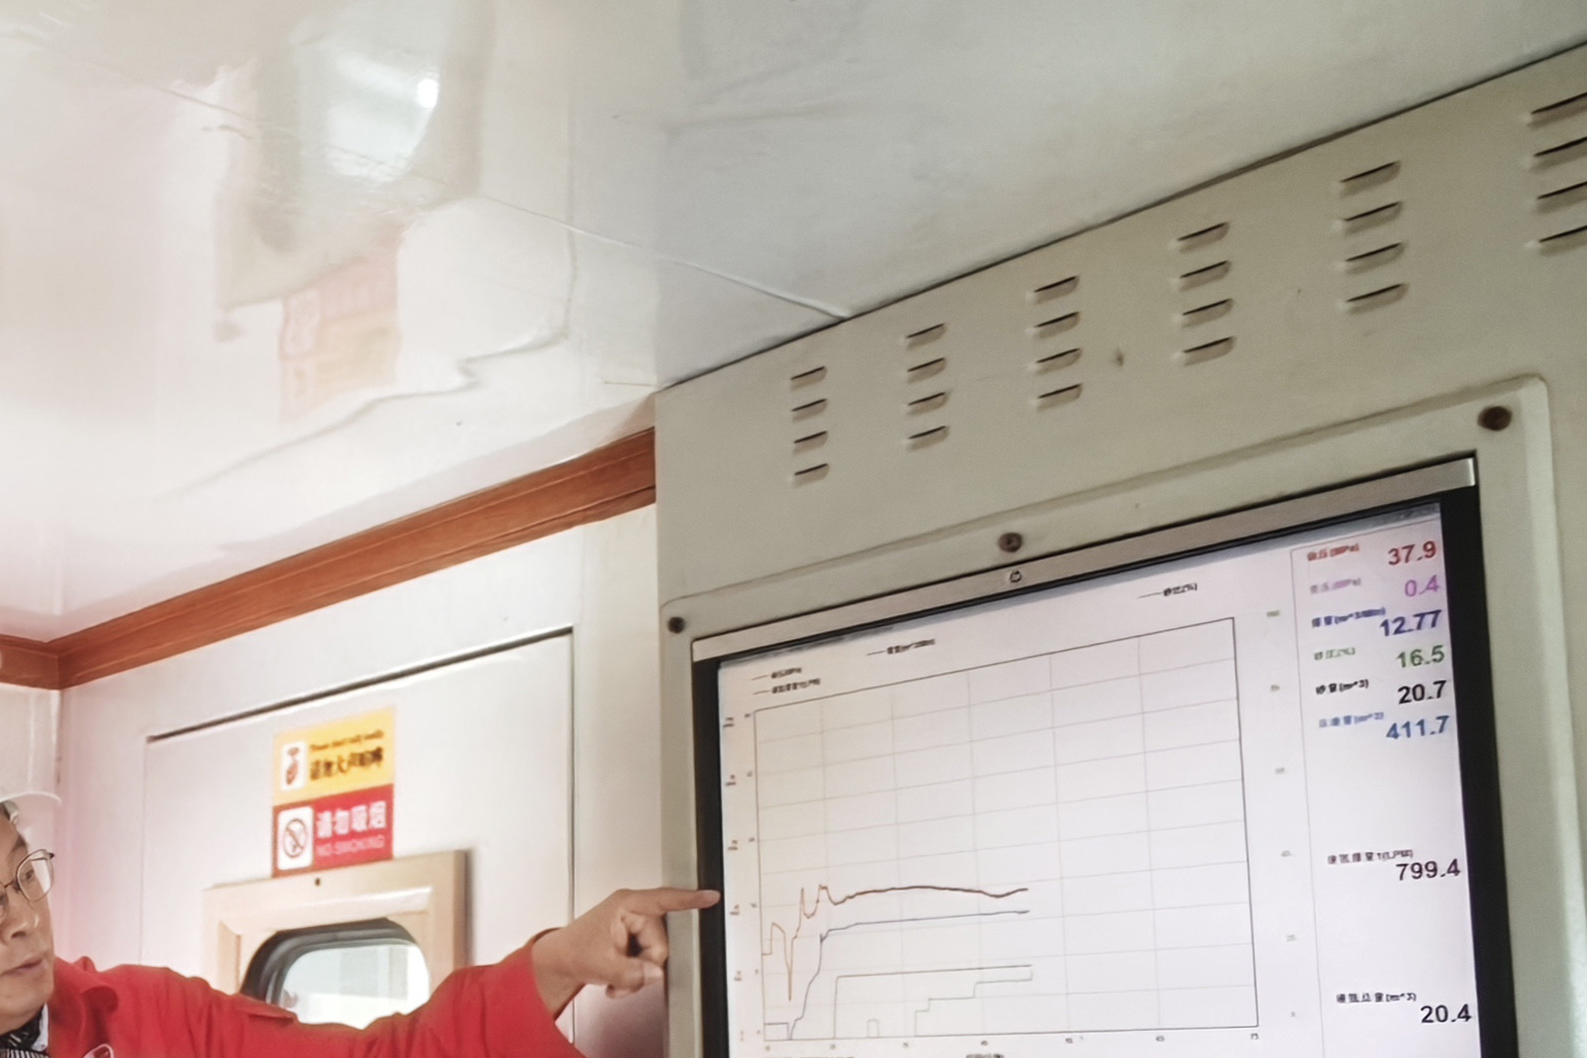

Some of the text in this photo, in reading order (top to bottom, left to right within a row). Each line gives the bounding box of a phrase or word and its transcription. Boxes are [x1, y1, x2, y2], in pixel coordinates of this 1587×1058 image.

[1388, 540, 1436, 566] 37.9
[1404, 574, 1439, 597] 0.4
[1380, 609, 1442, 637] 12.77
[1396, 644, 1445, 668] 16.5
[1397, 679, 1447, 704] 20.7
[1386, 715, 1450, 739] 411.7
[1396, 858, 1461, 881] 799.4
[1420, 1003, 1472, 1023] 20.4
